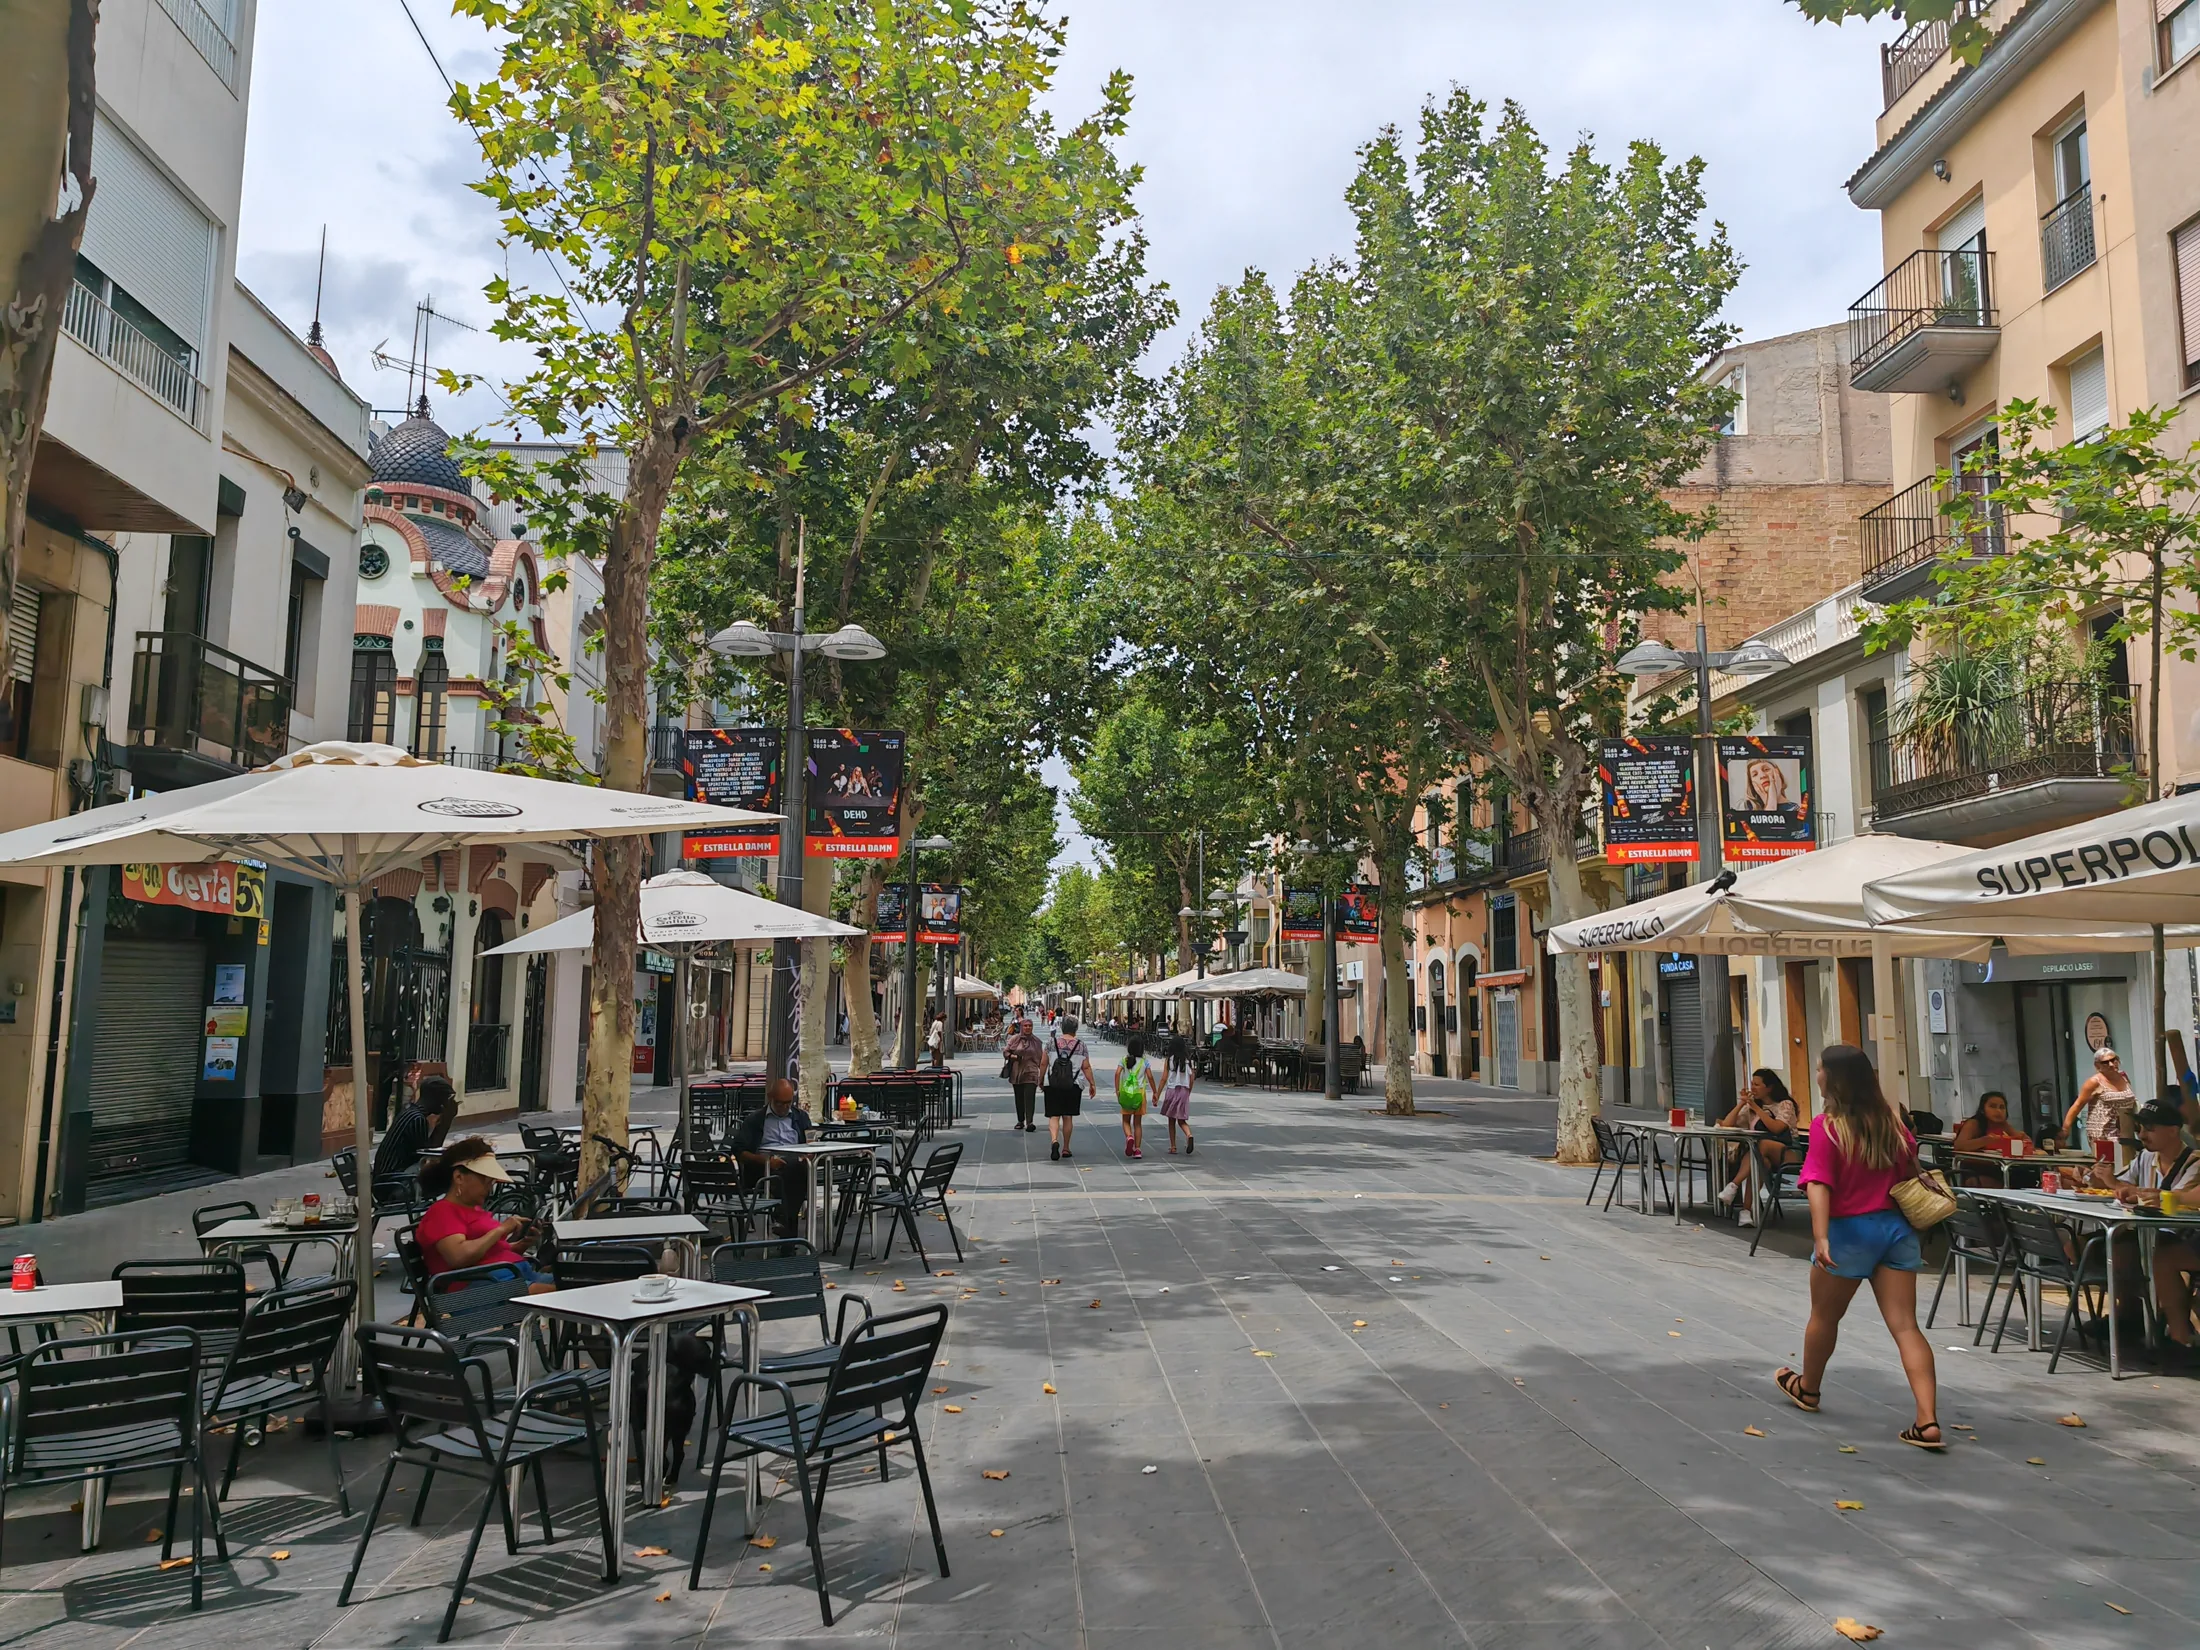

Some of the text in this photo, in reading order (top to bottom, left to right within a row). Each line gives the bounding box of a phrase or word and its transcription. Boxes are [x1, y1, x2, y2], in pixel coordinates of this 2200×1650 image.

[843, 810, 868, 819] DEHD
[1750, 815, 1786, 824] AURORA
[703, 842, 771, 852] ESTRELLA DAMM
[825, 843, 866, 852] ESTRELLA
[1628, 849, 1692, 858] ESTRELLA DAMM
[1741, 848, 1807, 856] ESTRELLA DAMM
[1578, 916, 1665, 948] SUPERPOLLO
[1660, 959, 1696, 973] FUNDA CASA
